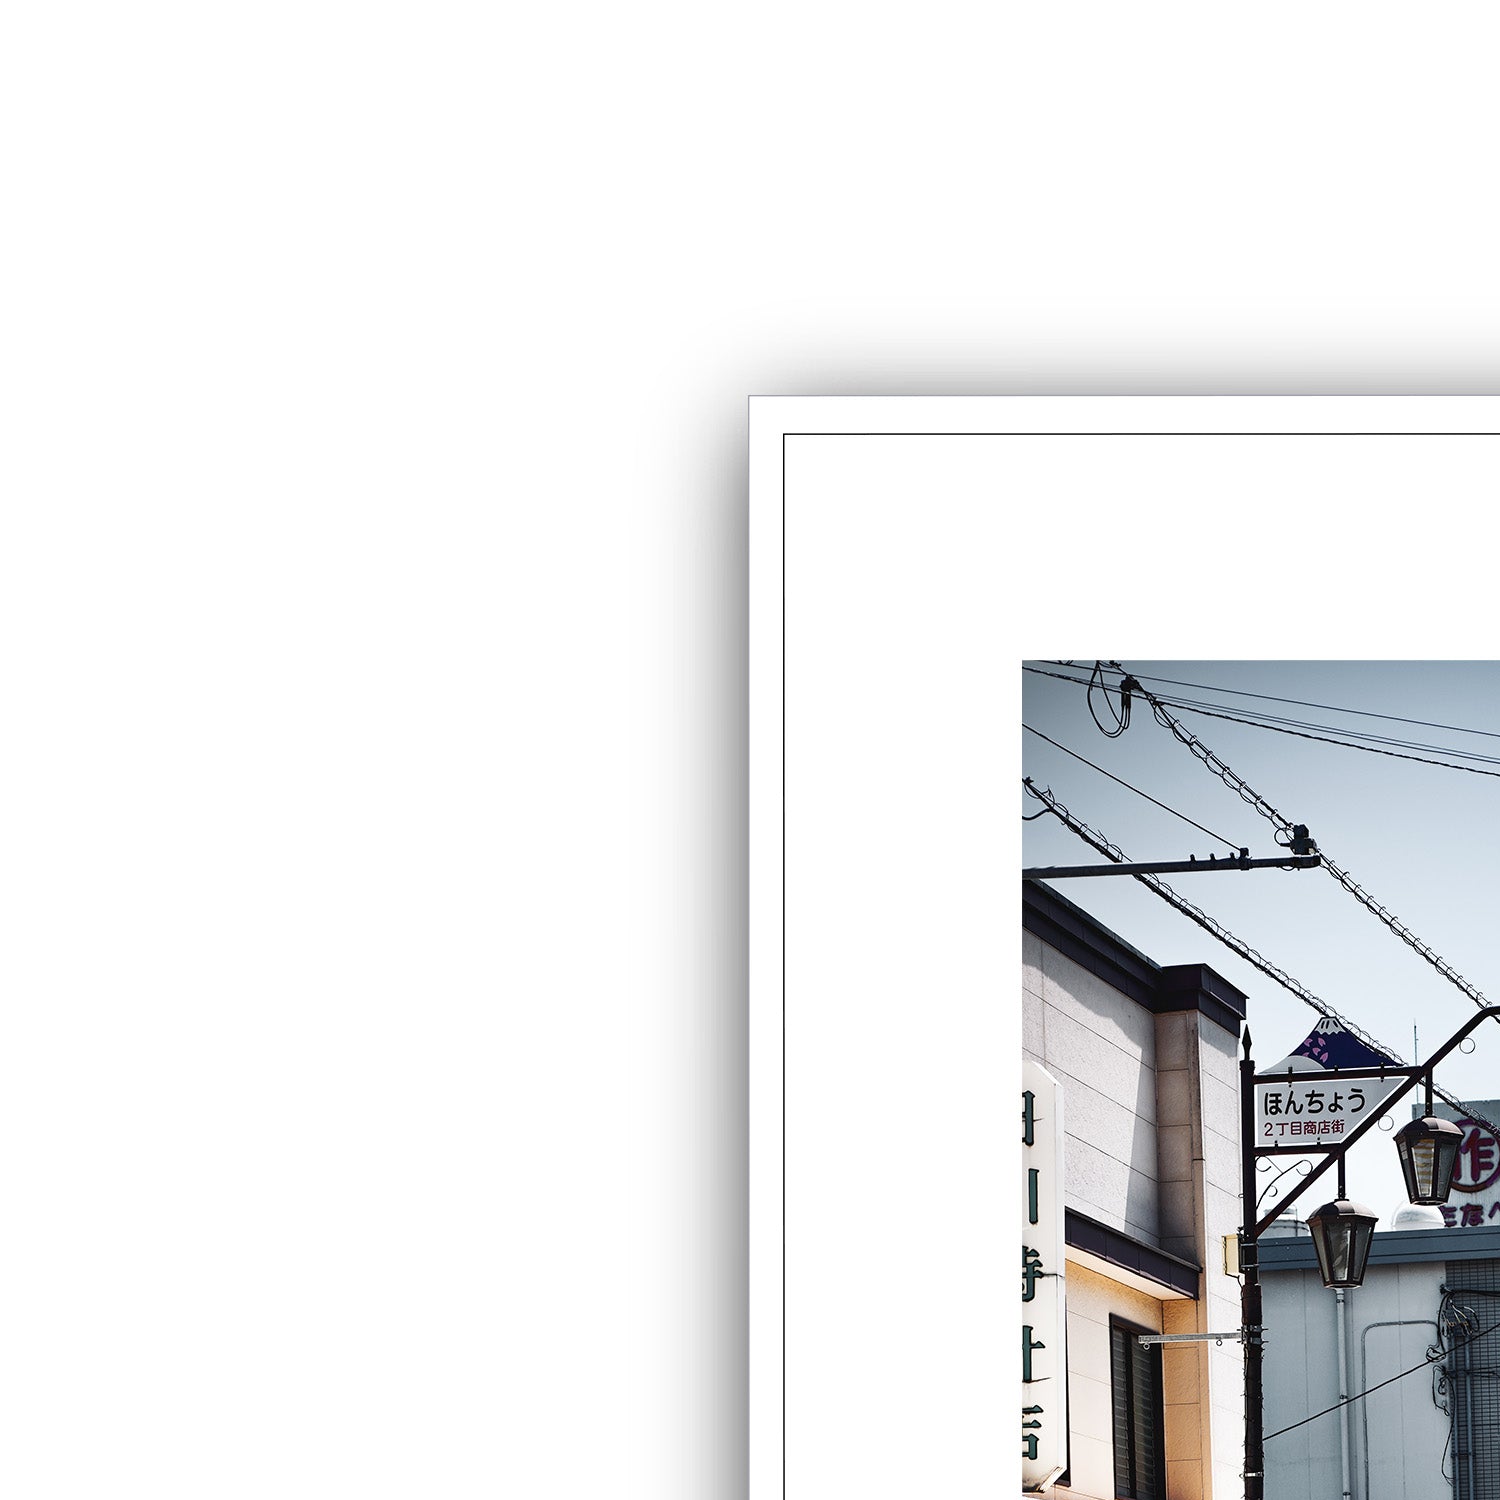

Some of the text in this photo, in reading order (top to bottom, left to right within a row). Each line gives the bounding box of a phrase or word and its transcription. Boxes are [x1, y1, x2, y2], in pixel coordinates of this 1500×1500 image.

[1264, 1088, 1366, 1116] ほんちょう
[1264, 1119, 1345, 1137] 2丁目商店街
